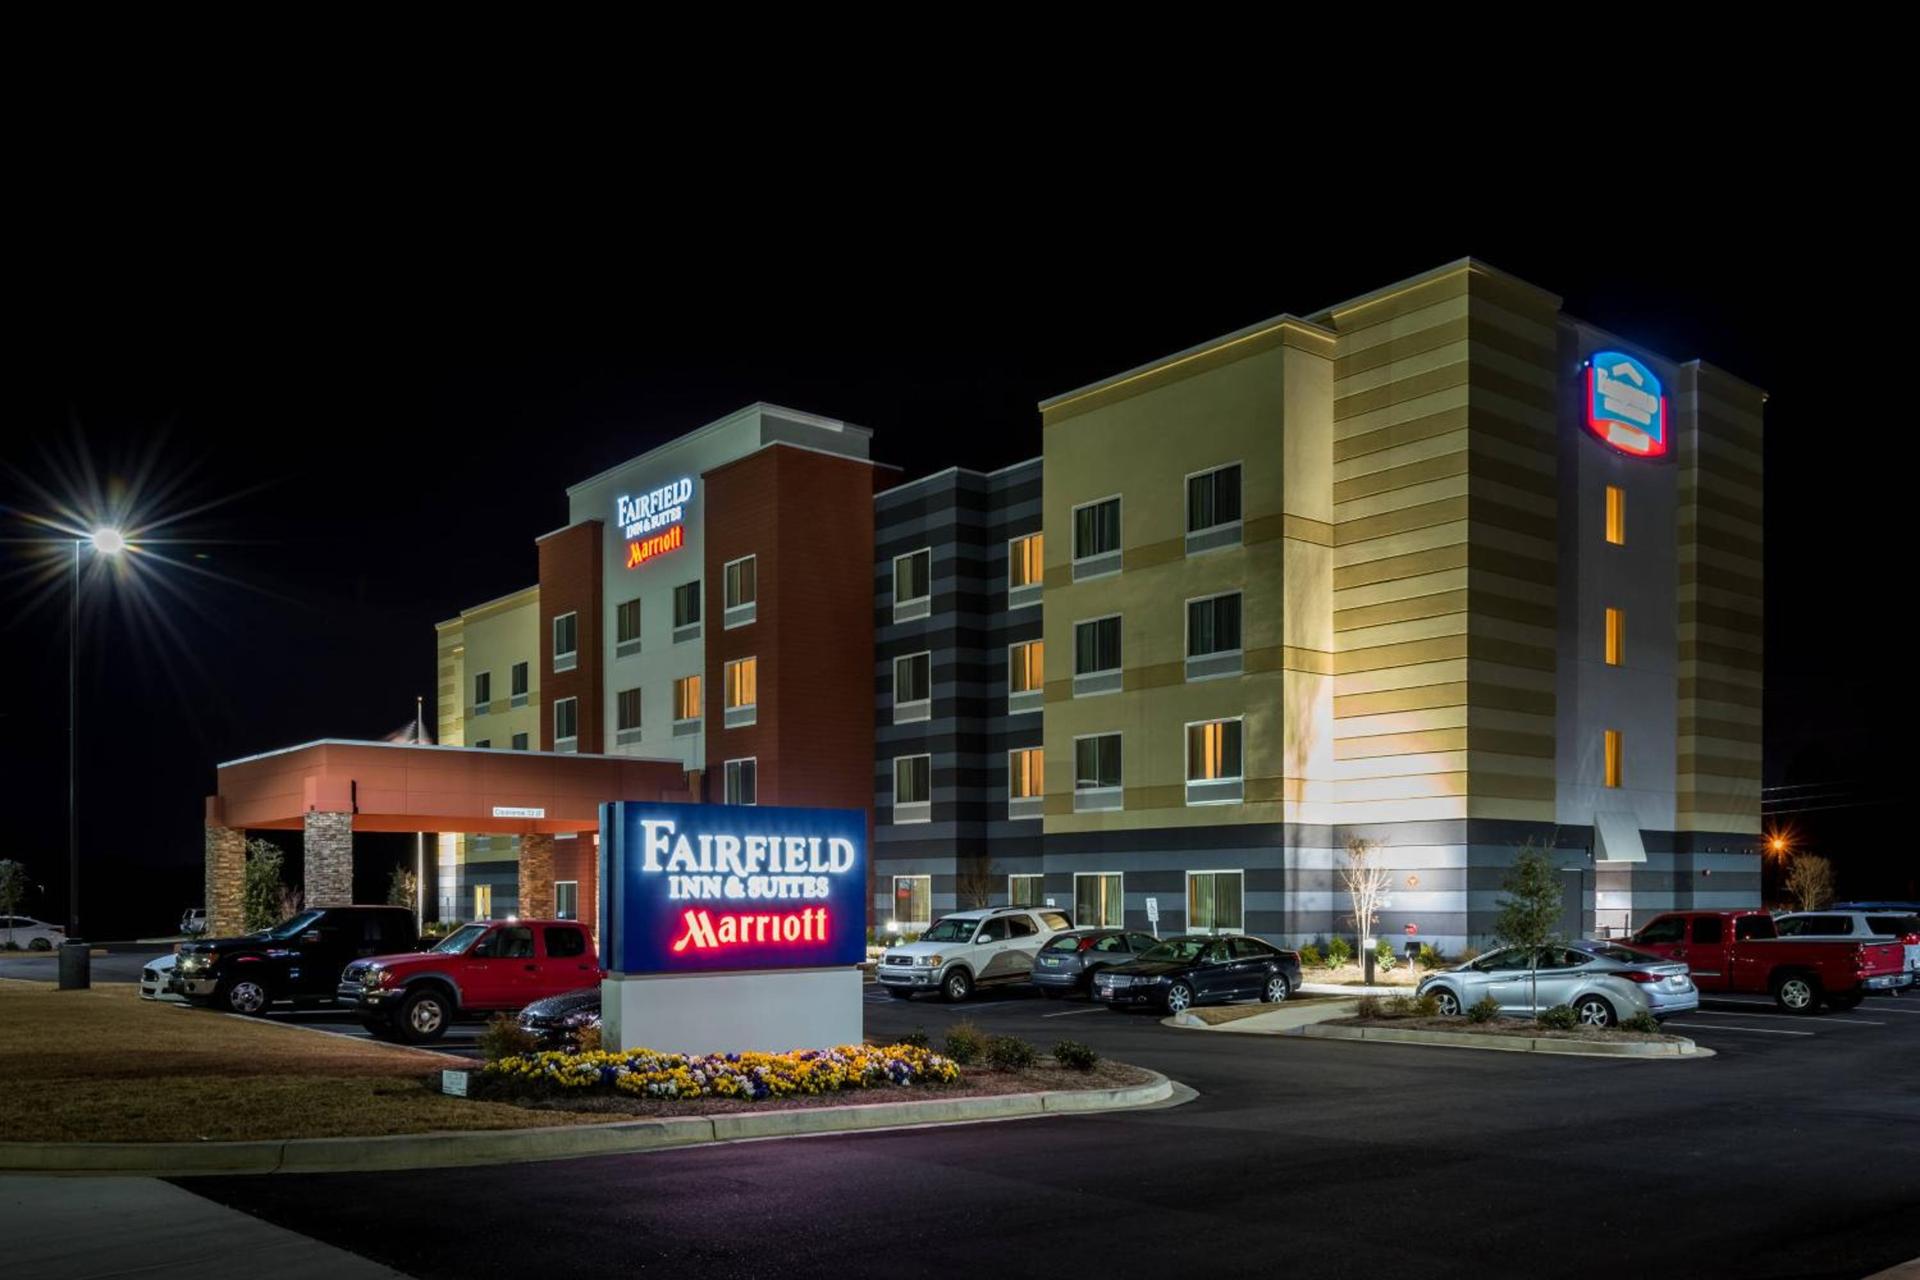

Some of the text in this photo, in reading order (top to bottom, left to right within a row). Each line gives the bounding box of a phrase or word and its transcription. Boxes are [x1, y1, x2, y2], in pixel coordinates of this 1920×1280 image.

[617, 478, 692, 527] FAIRFIELD
[627, 525, 682, 569] Marriott
[641, 819, 855, 877] FAIRFIELD
[673, 907, 828, 952] Marriott
